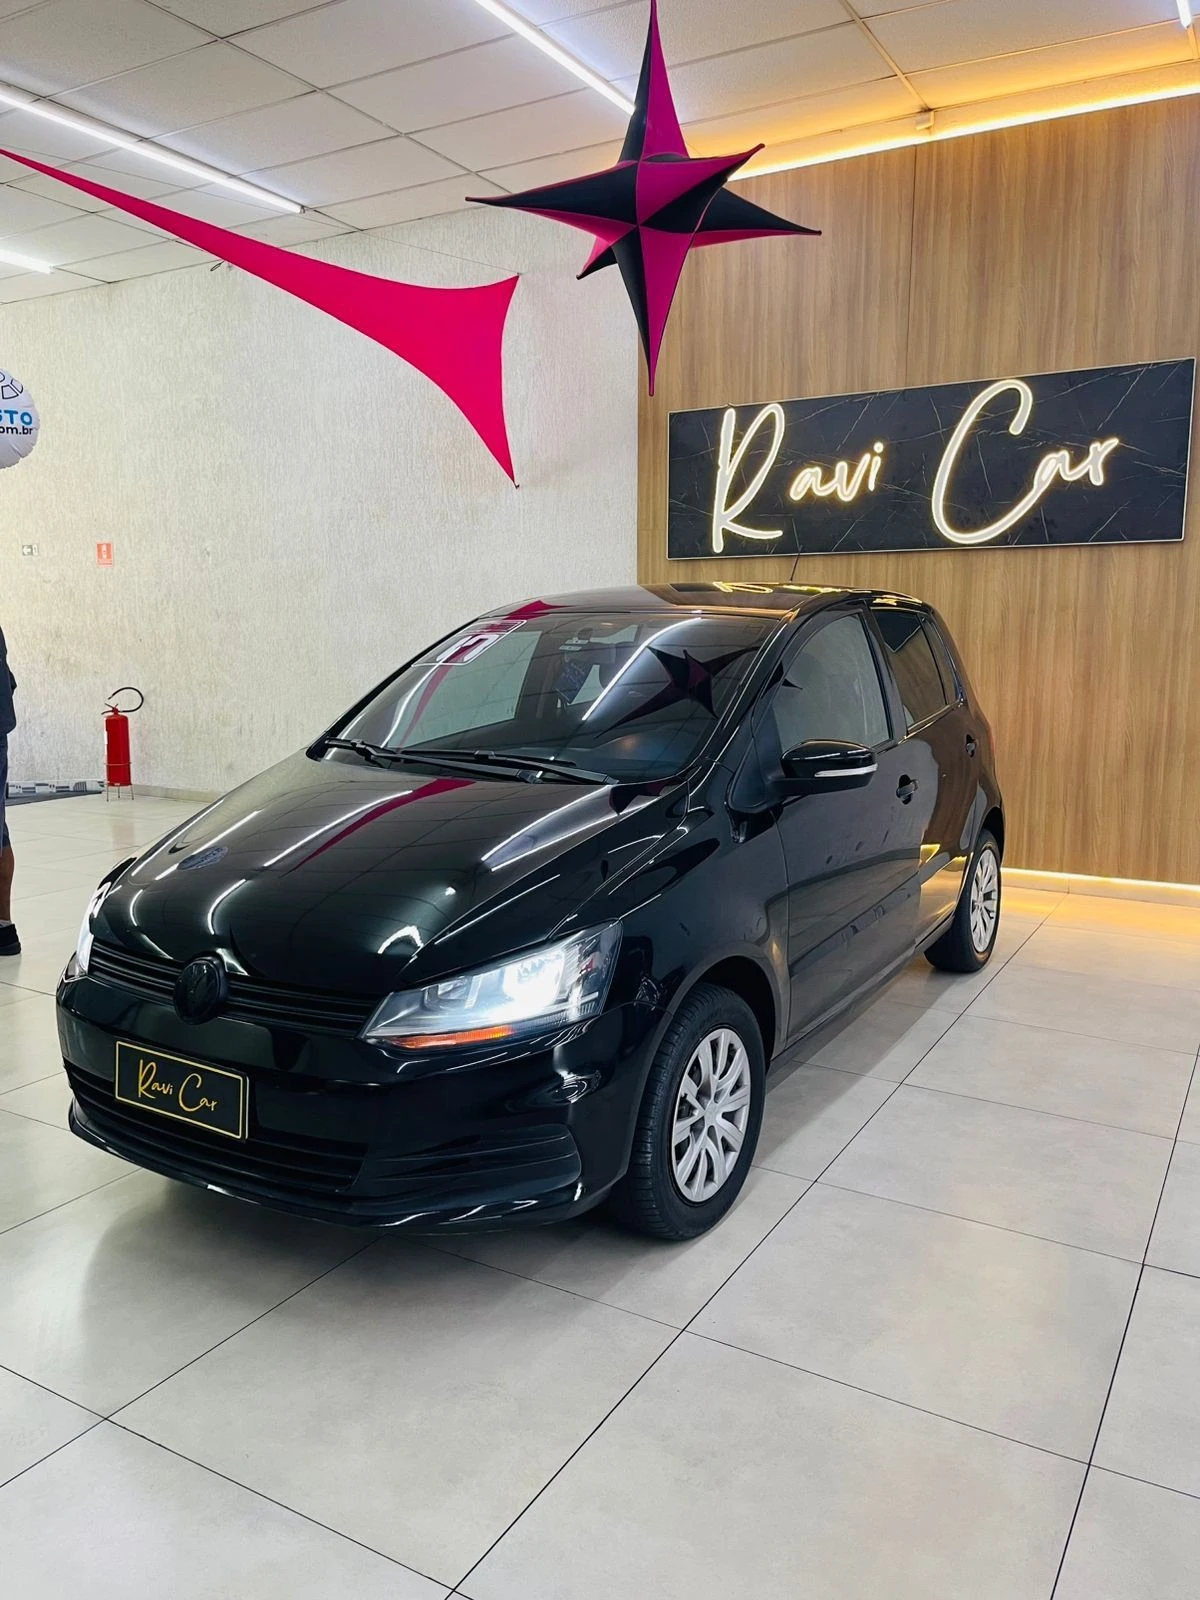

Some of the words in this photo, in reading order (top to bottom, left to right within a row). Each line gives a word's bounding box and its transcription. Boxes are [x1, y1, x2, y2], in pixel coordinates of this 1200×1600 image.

[0, 409, 33, 426] TO
[711, 403, 885, 554] Ravi
[931, 379, 1119, 544] Car
[137, 1059, 174, 1099] Ravi
[178, 1073, 218, 1112] Car
